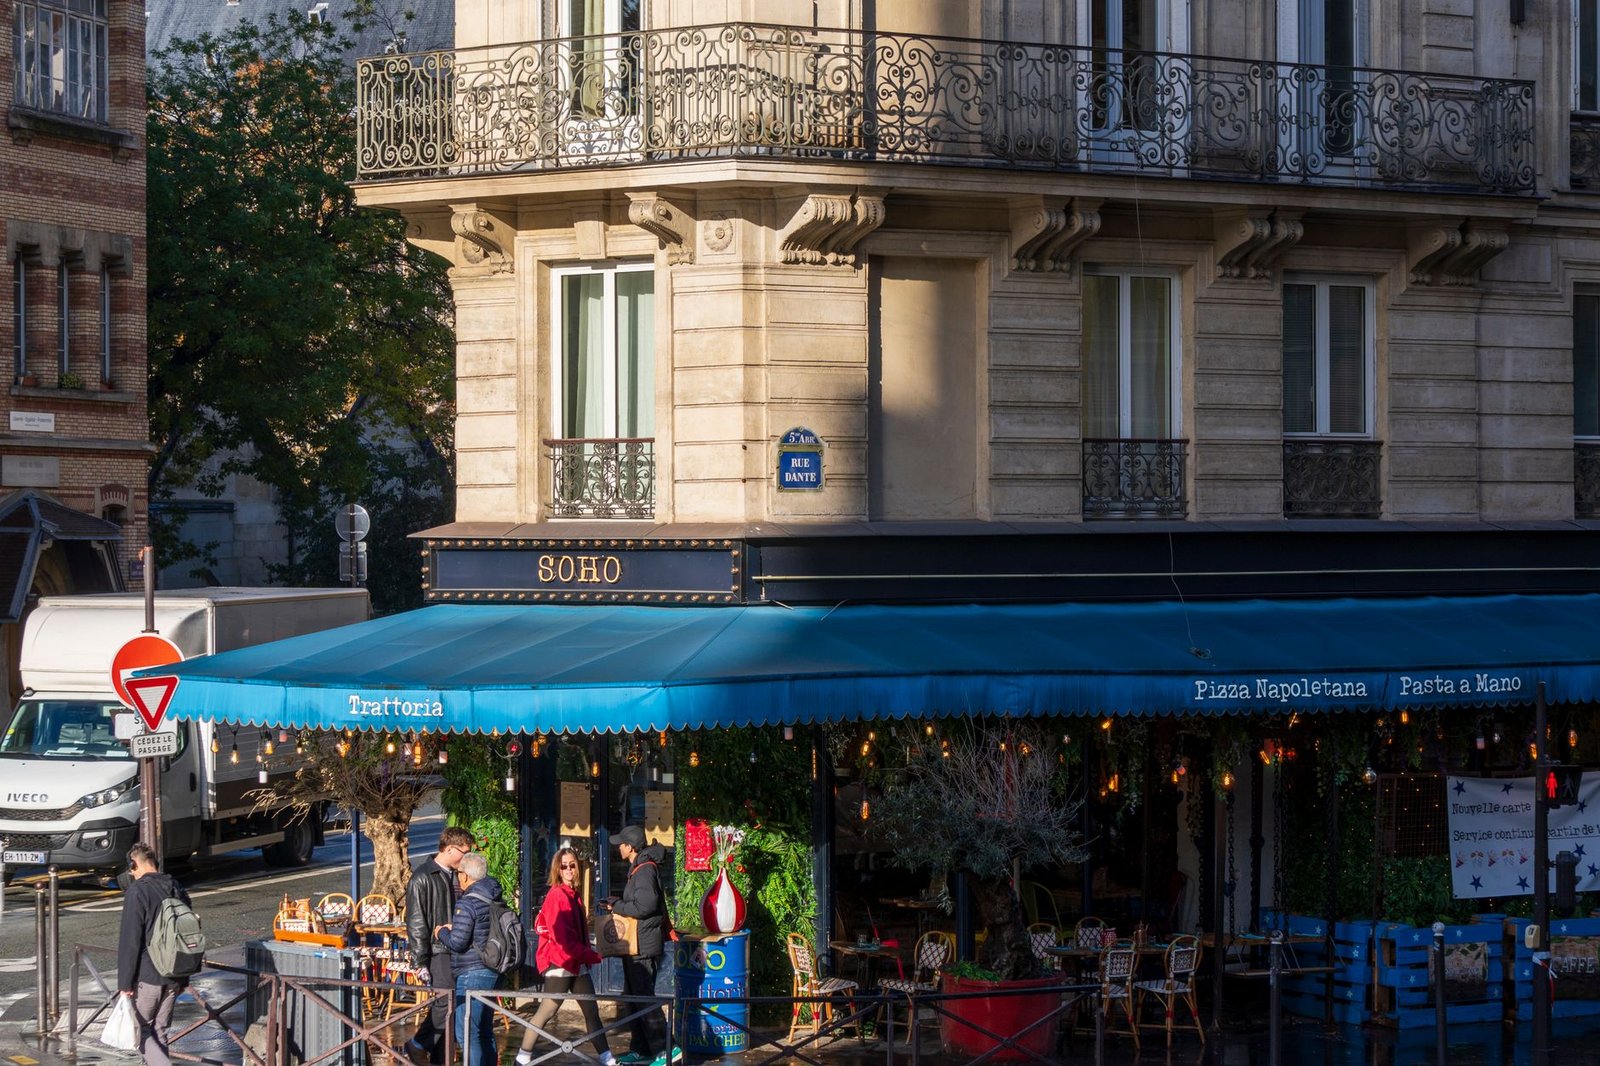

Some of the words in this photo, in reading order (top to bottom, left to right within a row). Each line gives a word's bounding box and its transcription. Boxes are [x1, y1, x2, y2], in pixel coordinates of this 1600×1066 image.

[791, 458, 810, 467] RUE
[785, 472, 817, 482] DANTE
[538, 554, 622, 584] SOHO
[1194, 680, 1251, 700] Pizza
[1256, 678, 1368, 703] Napoletana
[1400, 675, 1456, 696] Pasta
[1460, 679, 1471, 693] a
[1475, 673, 1522, 692] Mano
[348, 695, 444, 717] Trattoria
[163, 735, 172, 743] LE
[138, 744, 172, 754] PASSAGE
[6, 792, 49, 803] IVECO
[1452, 803, 1500, 816] Nouvelle
[1502, 803, 1531, 814] carte
[1453, 830, 1492, 842] Service
[1495, 828, 1534, 841] continu
[1582, 824, 1594, 835] de
[713, 1033, 745, 1048] CHER
